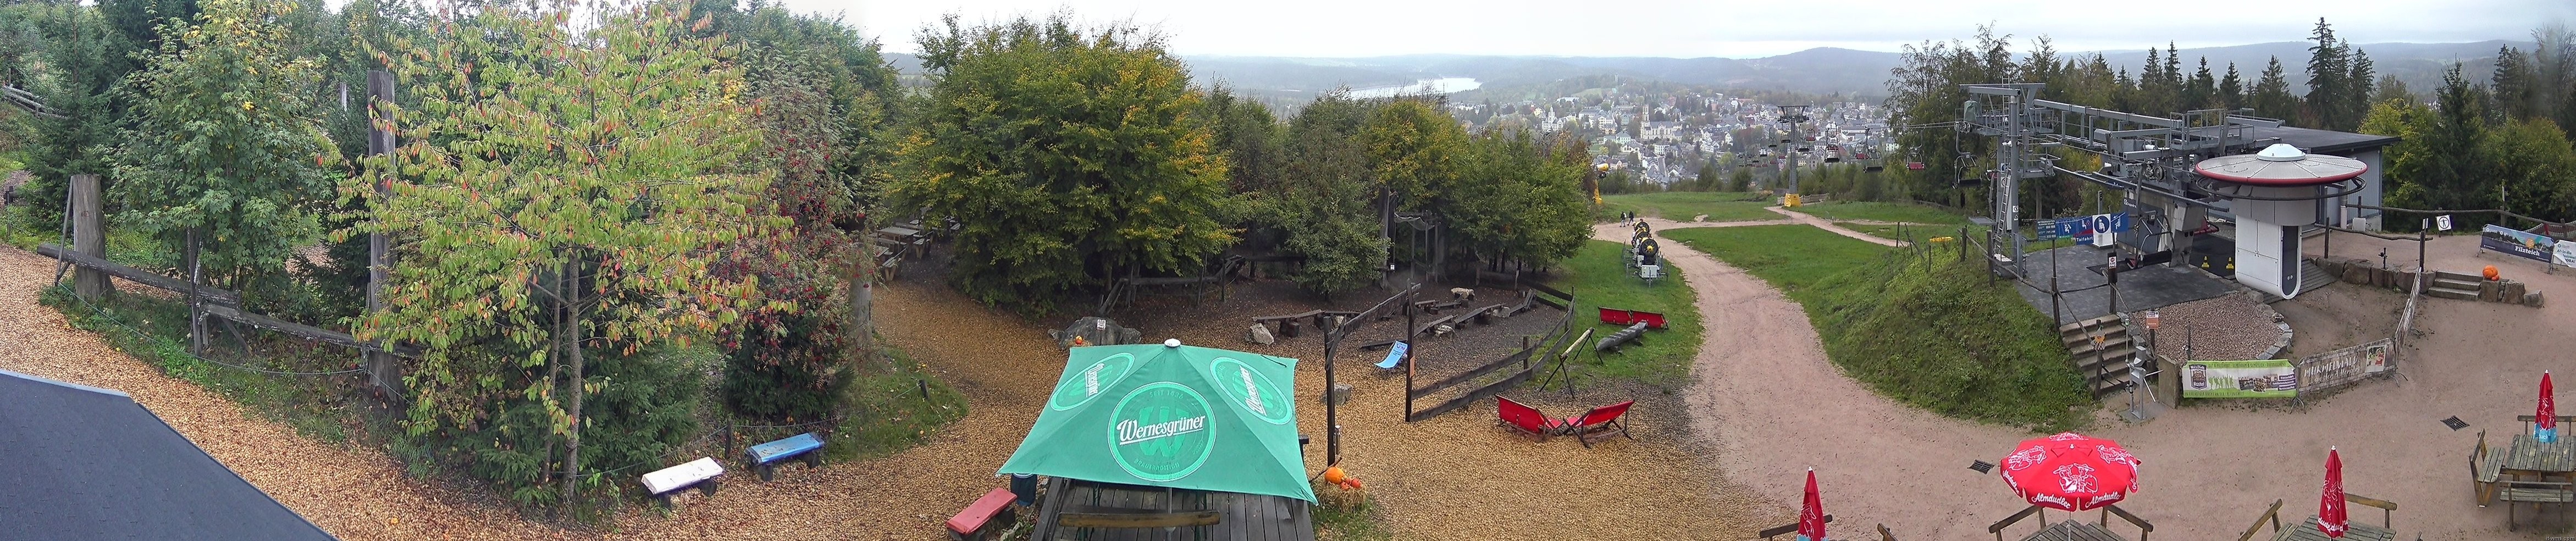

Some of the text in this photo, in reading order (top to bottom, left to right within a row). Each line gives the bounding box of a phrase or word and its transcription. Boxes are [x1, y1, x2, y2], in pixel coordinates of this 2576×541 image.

[2515, 246, 2540, 256] Filzteich
[1167, 390, 1184, 399] 1436
[1116, 415, 1206, 443] Wernesgrüner
[2031, 493, 2071, 509] Almdudler
